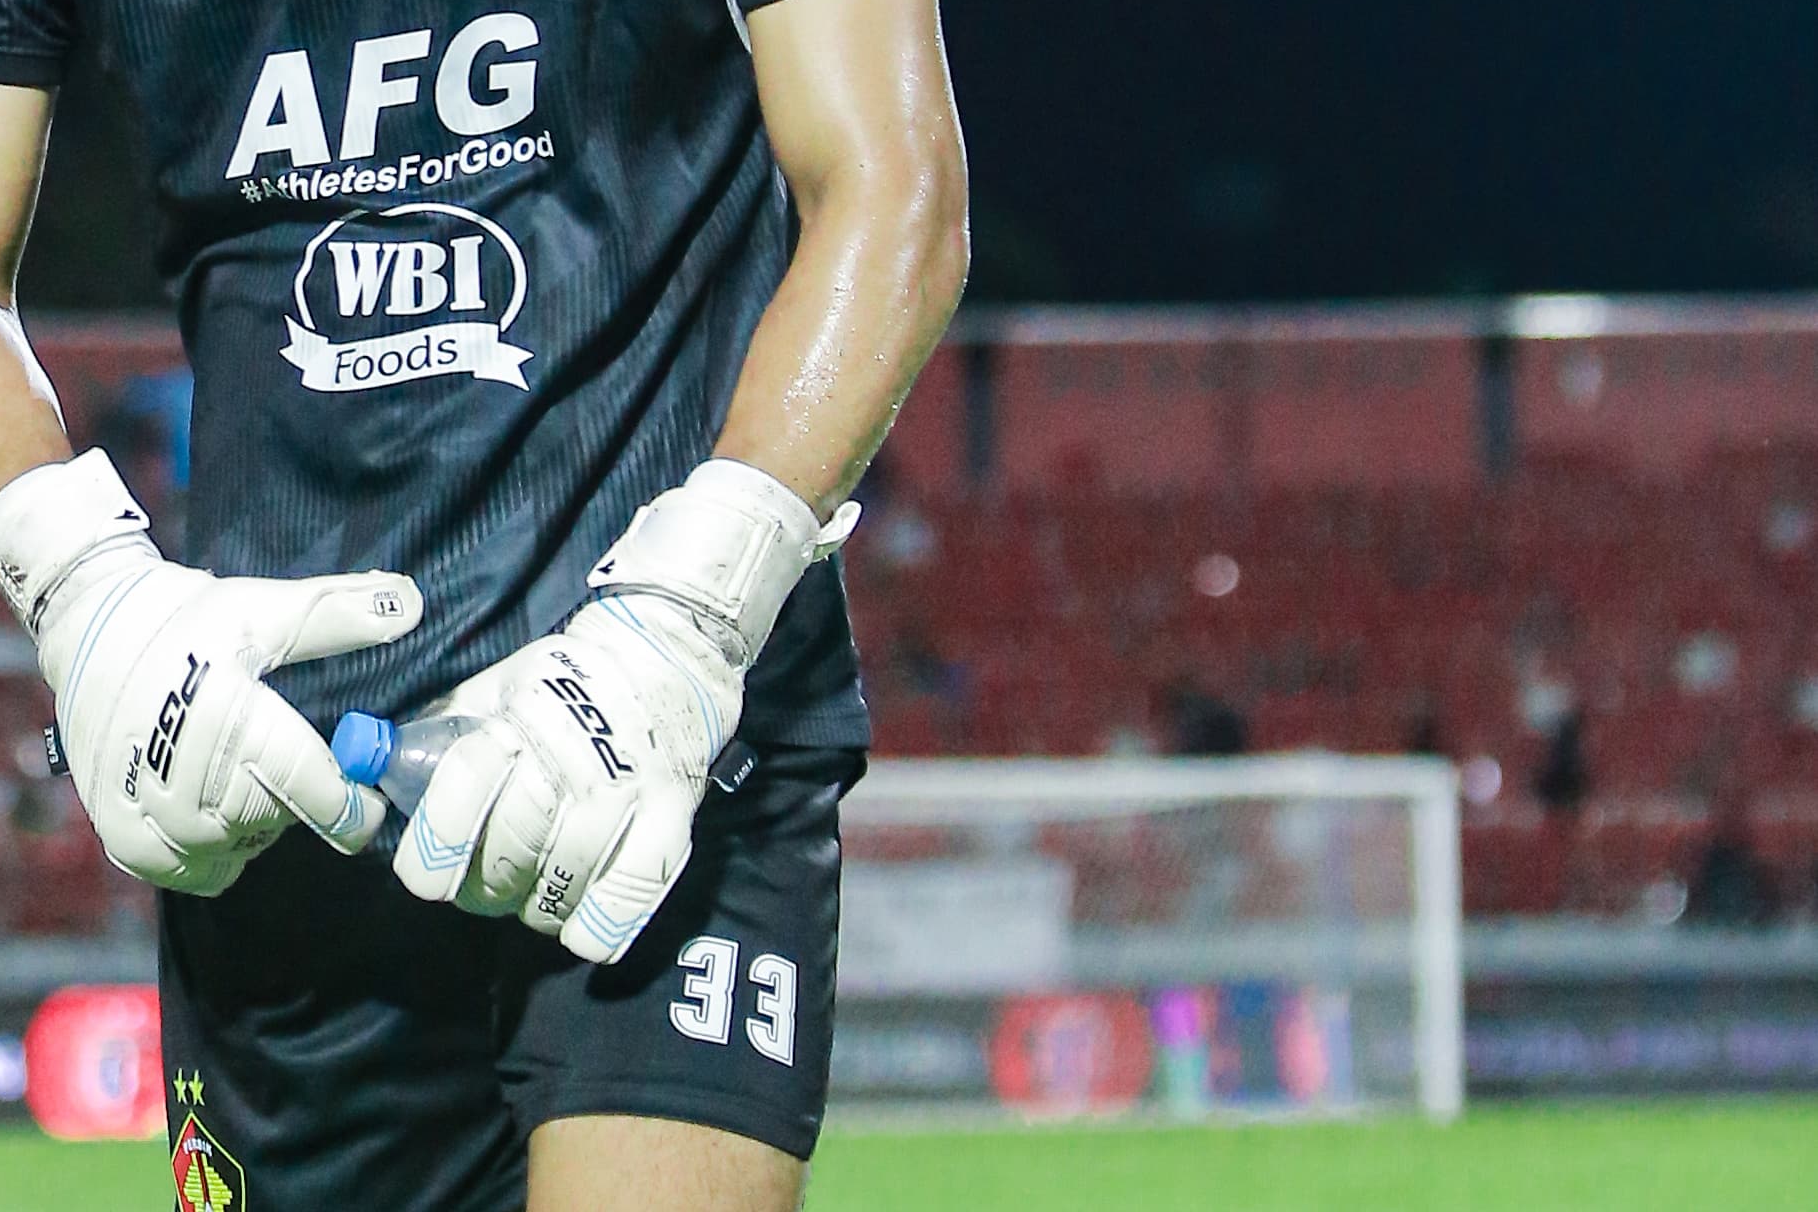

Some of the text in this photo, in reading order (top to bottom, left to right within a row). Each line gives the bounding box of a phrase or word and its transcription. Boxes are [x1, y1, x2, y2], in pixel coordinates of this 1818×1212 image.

[225, 11, 541, 180] AFG
[240, 130, 555, 204] #AthletesForGood
[328, 235, 487, 317] WBI
[335, 335, 459, 384] Foods
[669, 935, 798, 1068] 33
